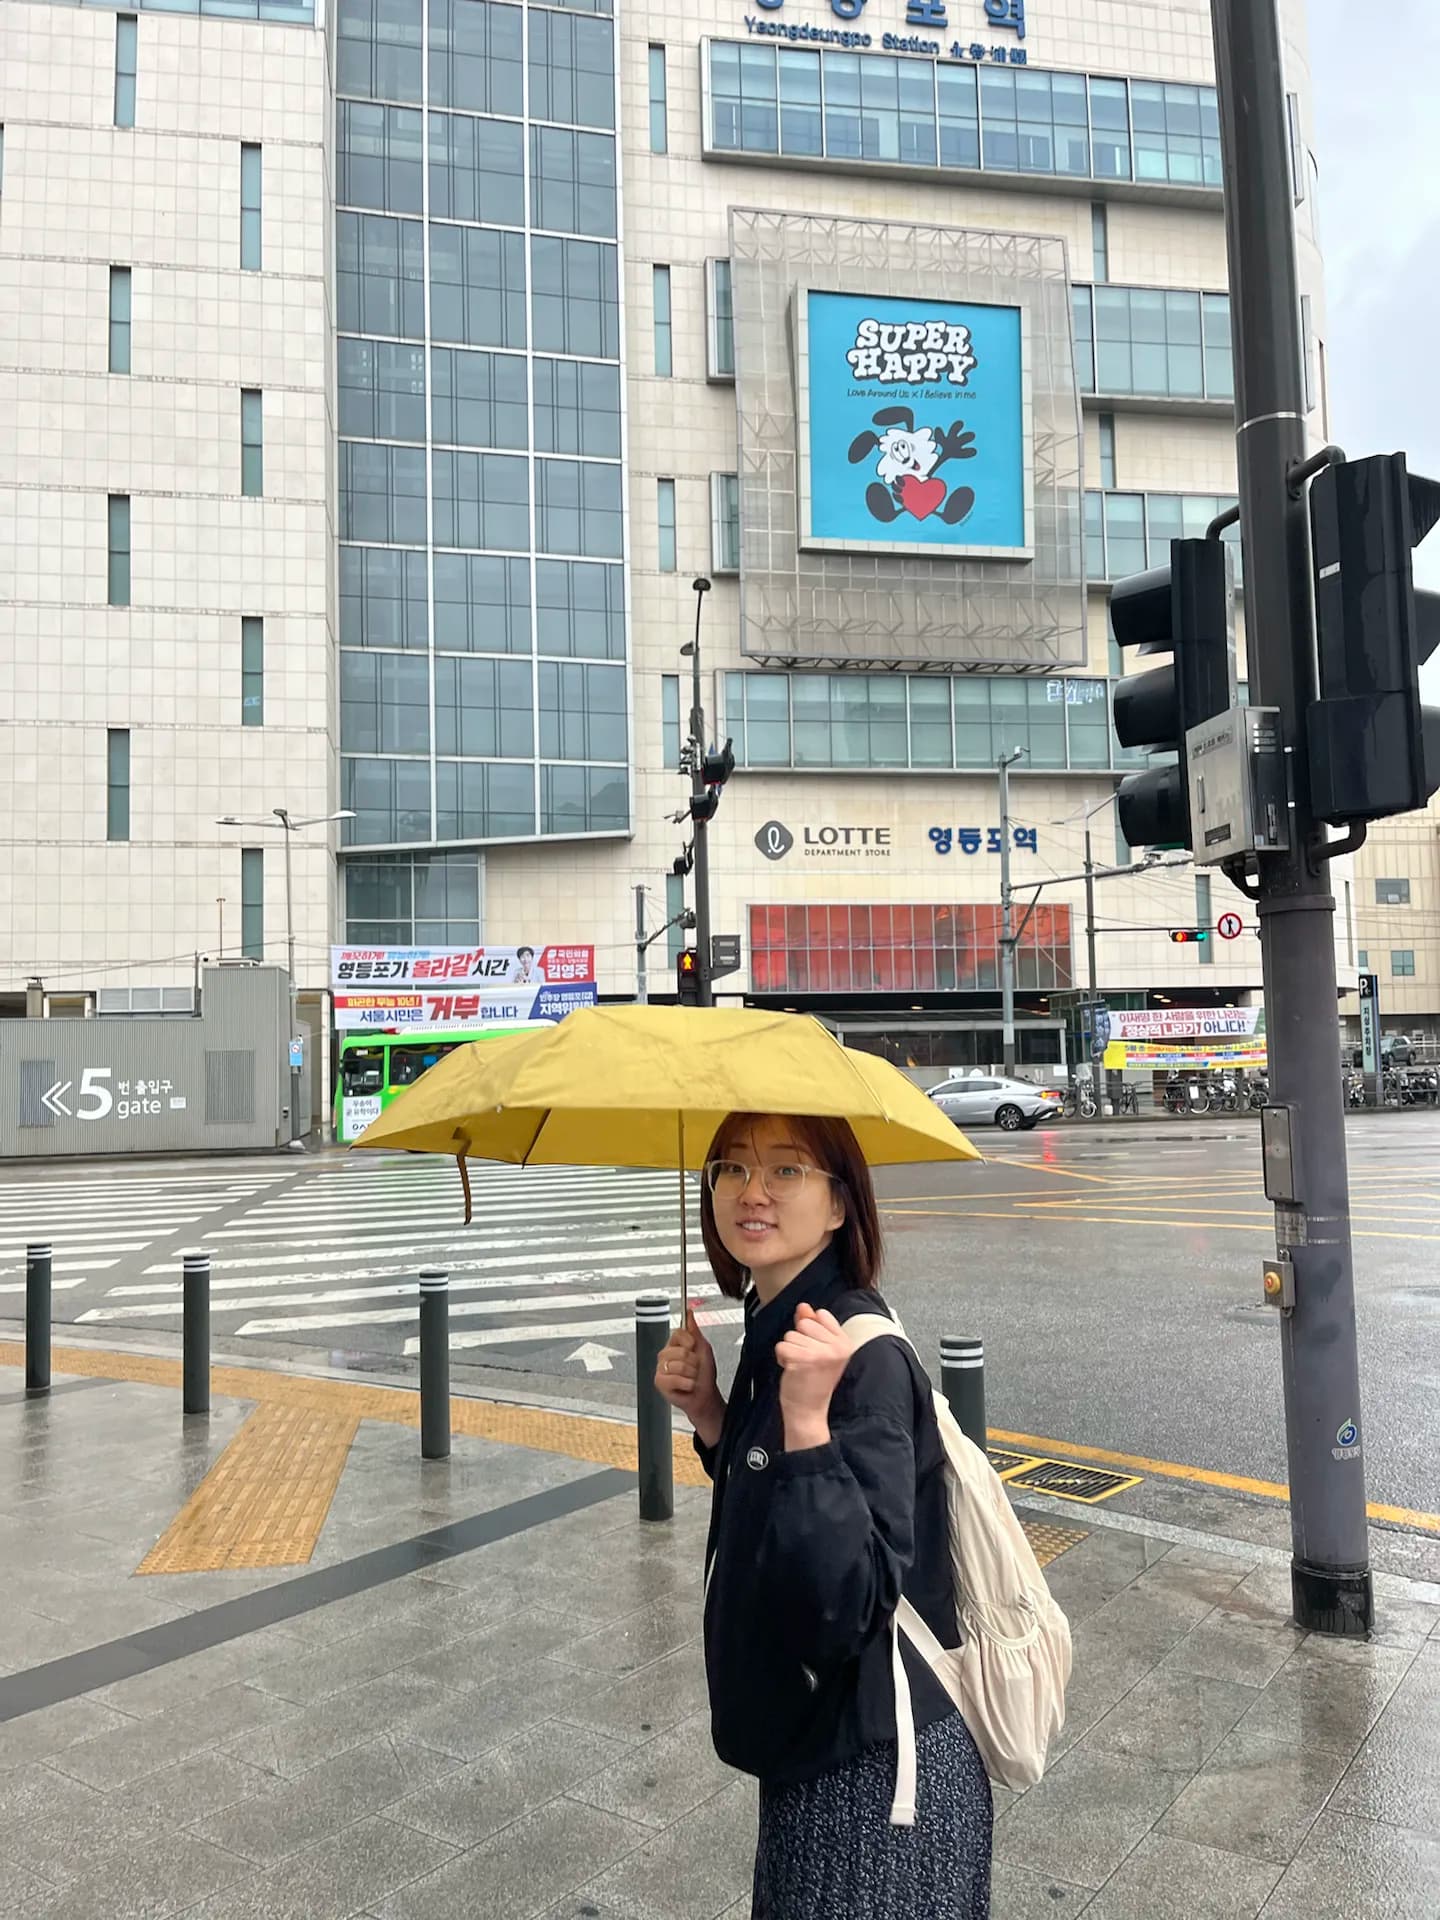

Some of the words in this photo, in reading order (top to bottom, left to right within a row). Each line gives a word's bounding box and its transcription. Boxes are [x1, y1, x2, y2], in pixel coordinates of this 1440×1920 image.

[743, 15, 872, 48] Yeongdeungpo
[881, 33, 940, 55] Station
[856, 318, 971, 354] SUPER
[846, 347, 978, 386] HAPPY
[847, 388, 866, 397] Love
[867, 388, 897, 398] Around
[898, 389, 909, 398] Us
[924, 390, 952, 399] Believe
[955, 391, 963, 399] in
[804, 826, 891, 845] LOTTE
[928, 826, 1038, 855] 영등포역
[804, 848, 862, 857] DEPARTMENT
[865, 848, 891, 857] STORE
[337, 961, 409, 979] 영등포가
[412, 953, 473, 978] 올라갈
[472, 958, 510, 977] 시간
[547, 963, 589, 979] 김영주
[1360, 978, 1368, 996] P
[360, 1008, 424, 1023] 서울시민은
[427, 994, 480, 1021] 거부
[76, 1067, 113, 1120] 5
[118, 1081, 131, 1095] 번
[135, 1080, 173, 1095] 출입구
[117, 1098, 162, 1119] gate
